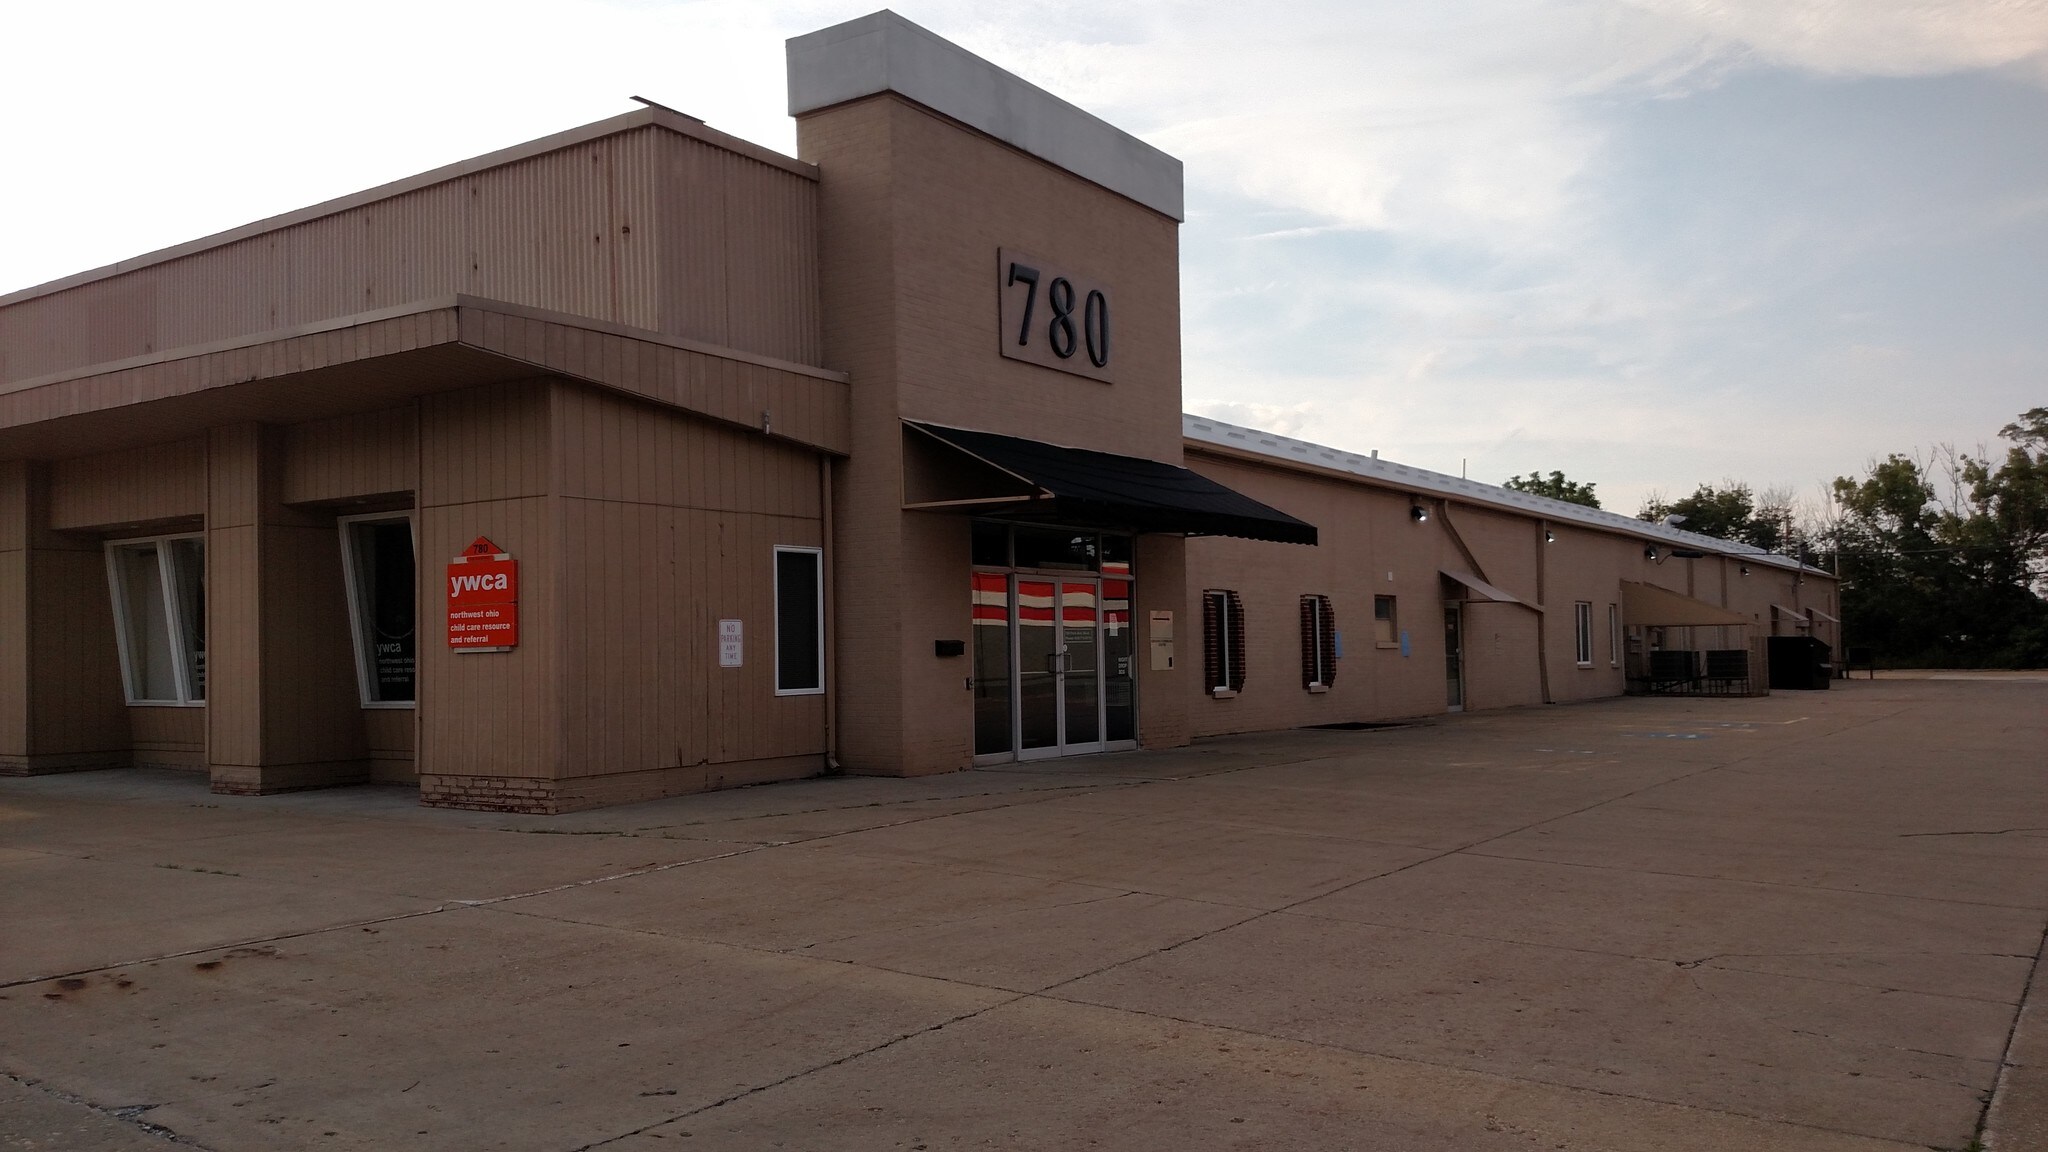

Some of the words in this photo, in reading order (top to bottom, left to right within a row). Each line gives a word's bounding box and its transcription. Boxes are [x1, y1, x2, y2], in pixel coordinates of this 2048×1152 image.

[1008, 262, 1109, 368] 780
[473, 543, 489, 554] 780
[450, 573, 508, 598] ywca
[450, 610, 484, 619] northwest
[485, 609, 500, 618] ohio
[450, 623, 465, 632] child
[482, 623, 511, 631] resource
[726, 624, 736, 633] NO
[450, 636, 463, 644] and
[463, 634, 489, 643] referral
[720, 634, 741, 643] PARKING
[376, 643, 402, 657] ywca
[725, 652, 737, 660] TIME
